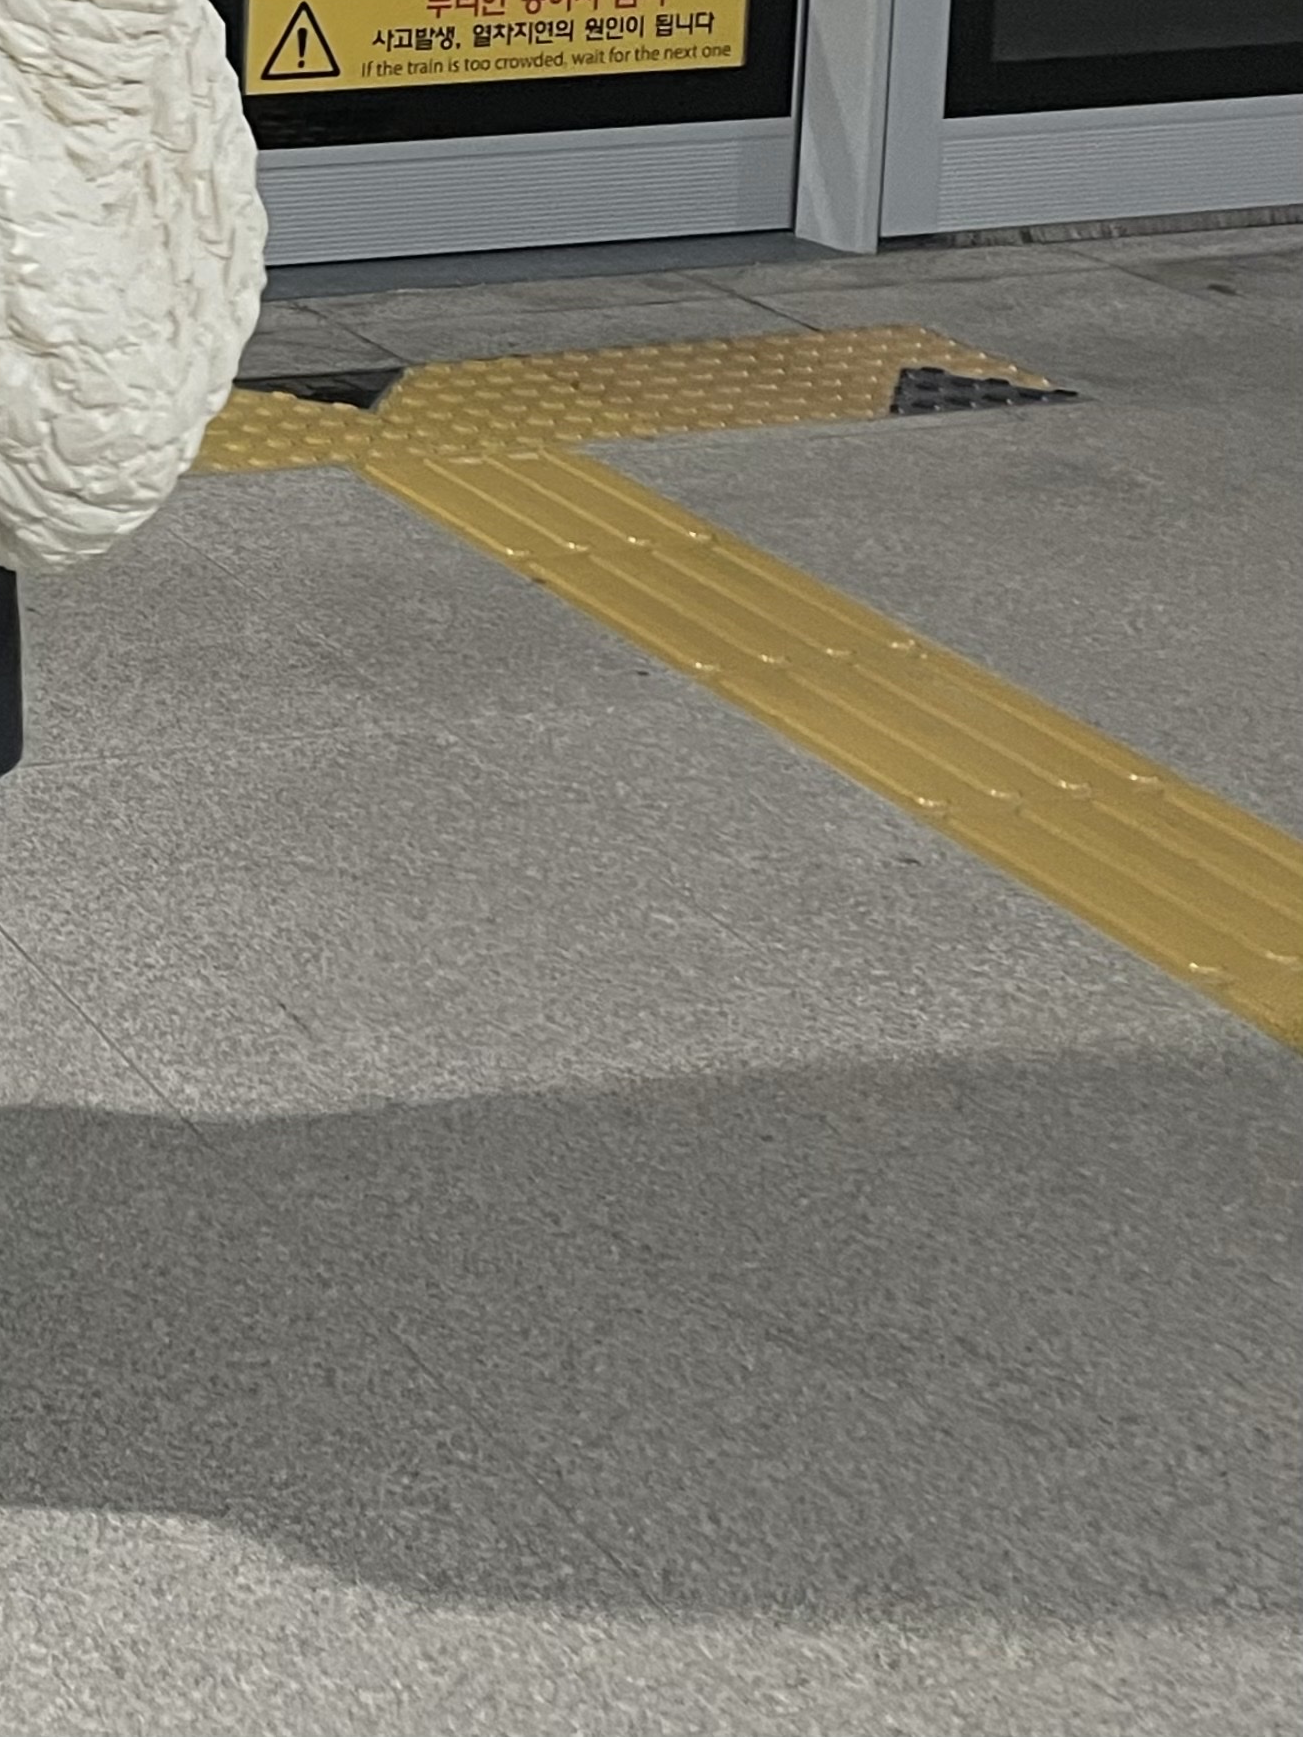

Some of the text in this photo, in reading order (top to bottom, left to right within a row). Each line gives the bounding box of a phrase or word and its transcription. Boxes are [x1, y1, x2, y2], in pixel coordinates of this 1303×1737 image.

[371, 10, 715, 53] 사고발생, 열차지연의 원인이 됩니다
[361, 60, 374, 78] If
[376, 59, 403, 77] the
[406, 59, 444, 76] train
[447, 57, 460, 73] is
[464, 55, 491, 72] too
[571, 47, 605, 66] wait
[608, 45, 632, 64] for
[634, 42, 661, 62] the
[663, 43, 698, 61] next
[701, 43, 732, 59] one
